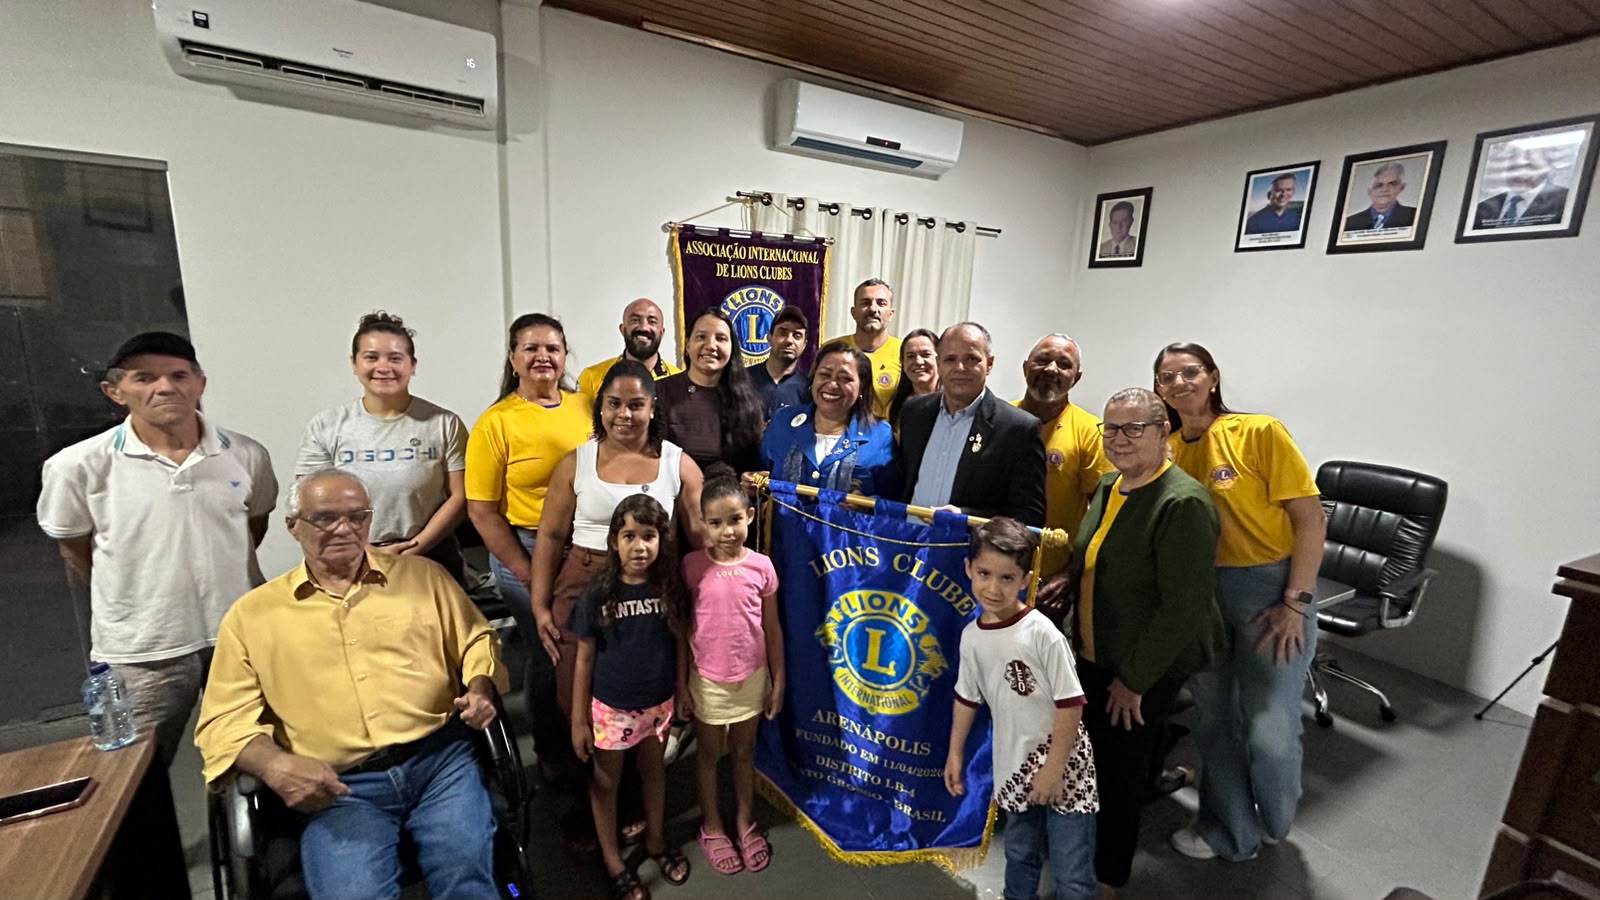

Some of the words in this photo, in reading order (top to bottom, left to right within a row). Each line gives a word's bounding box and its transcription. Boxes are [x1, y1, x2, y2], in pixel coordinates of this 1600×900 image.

[685, 240, 746, 261] ASSOCIAÇÃO
[748, 246, 819, 264] INTERNACIONAL
[716, 262, 729, 277] DE
[731, 264, 758, 279] LIONS
[760, 265, 793, 280] CLUBES
[732, 288, 780, 312] LIONS
[746, 314, 768, 344] L
[808, 545, 880, 577] LIONS
[893, 553, 978, 617] CLUBE
[843, 592, 925, 635] LIONS
[862, 627, 897, 677] L
[837, 671, 913, 709] INTERNATIONAL
[1014, 662, 1026, 692] LEO
[795, 728, 858, 755] FUNDADO
[860, 748, 879, 765] EM
[812, 709, 933, 756] ARENÁPOLIS
[815, 755, 881, 785] DISTRITO
[885, 778, 916, 798] LB-4
[894, 797, 946, 823] BRASIL
